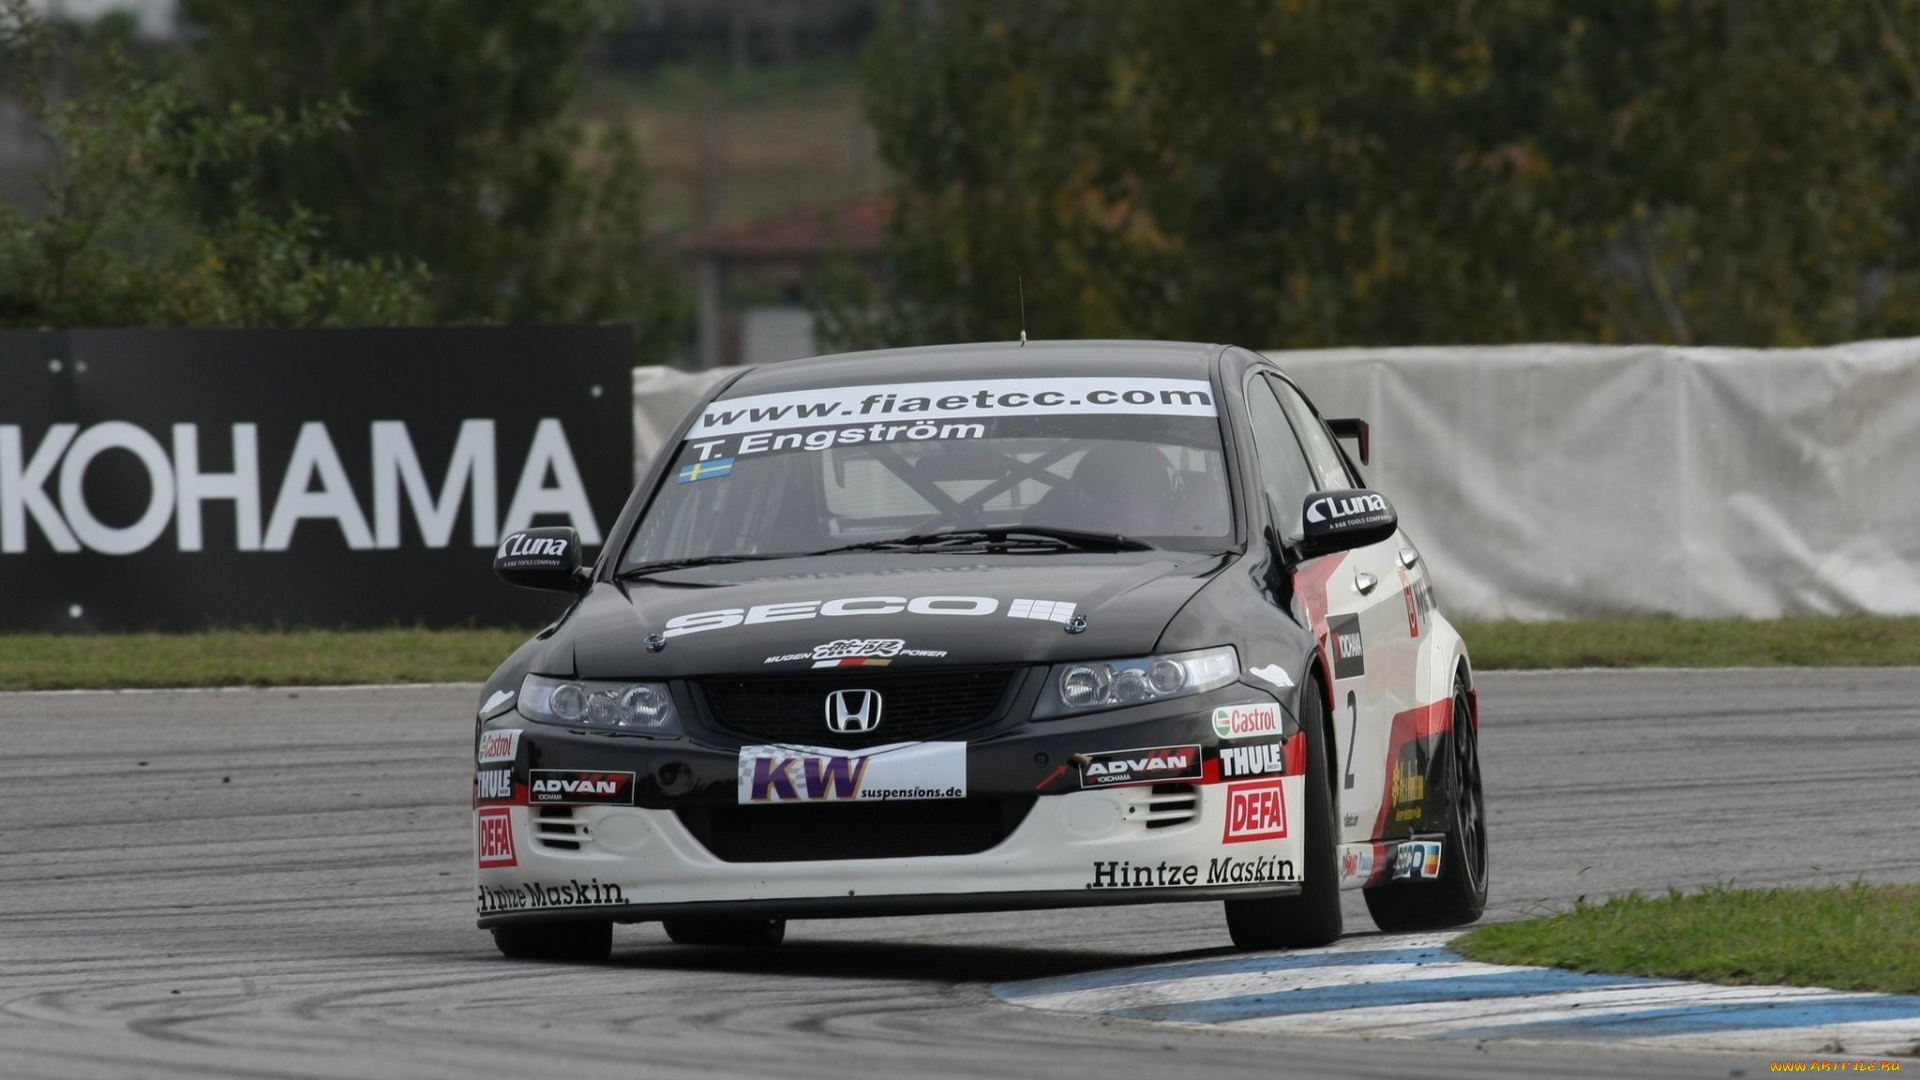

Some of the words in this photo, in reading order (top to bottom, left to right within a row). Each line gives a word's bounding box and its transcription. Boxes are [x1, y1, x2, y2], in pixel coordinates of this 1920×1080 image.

[703, 387, 1212, 428] www.fiaetcc.com
[693, 438, 725, 462] T.
[737, 420, 986, 456] Engström
[0, 418, 602, 556] KOHAMA
[1326, 493, 1387, 519] Luna
[510, 533, 568, 556] Luna
[662, 596, 1000, 637] SECO
[764, 652, 813, 664] MUGEN
[899, 649, 948, 658] POWER
[1231, 707, 1276, 734] Castrol
[484, 732, 513, 759] Castrol
[1344, 690, 1358, 789] 2
[1086, 755, 1187, 777] ADVAN
[1219, 743, 1282, 777] THULE
[532, 779, 617, 794] ADVAN
[751, 756, 871, 802] KW
[861, 786, 963, 800] suspensions.de
[1232, 791, 1281, 832] DEFA
[480, 818, 510, 858] DEFA
[1093, 861, 1199, 888] Hintze
